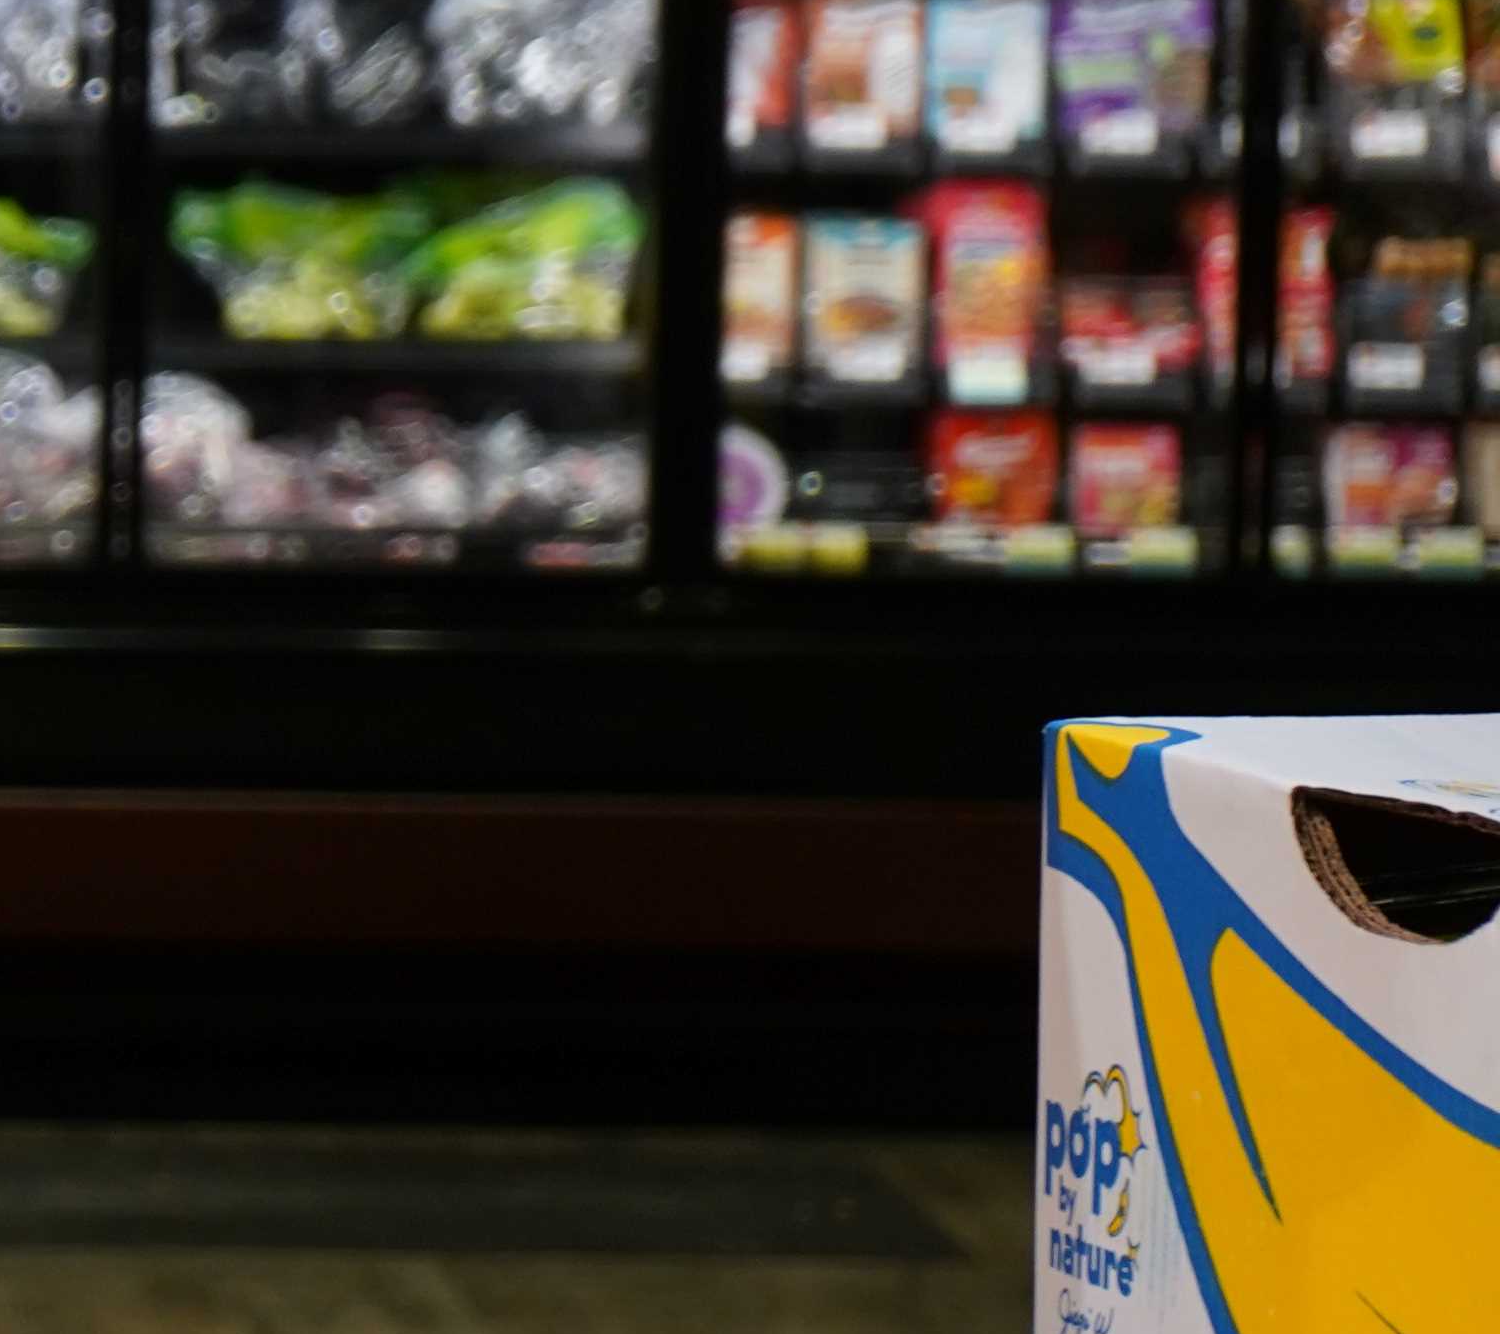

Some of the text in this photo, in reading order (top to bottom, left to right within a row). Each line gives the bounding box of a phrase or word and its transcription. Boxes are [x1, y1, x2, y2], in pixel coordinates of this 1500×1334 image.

[1045, 1099, 1121, 1216] pop
[1058, 1174, 1077, 1225] by
[1049, 1225, 1134, 1297] nature
